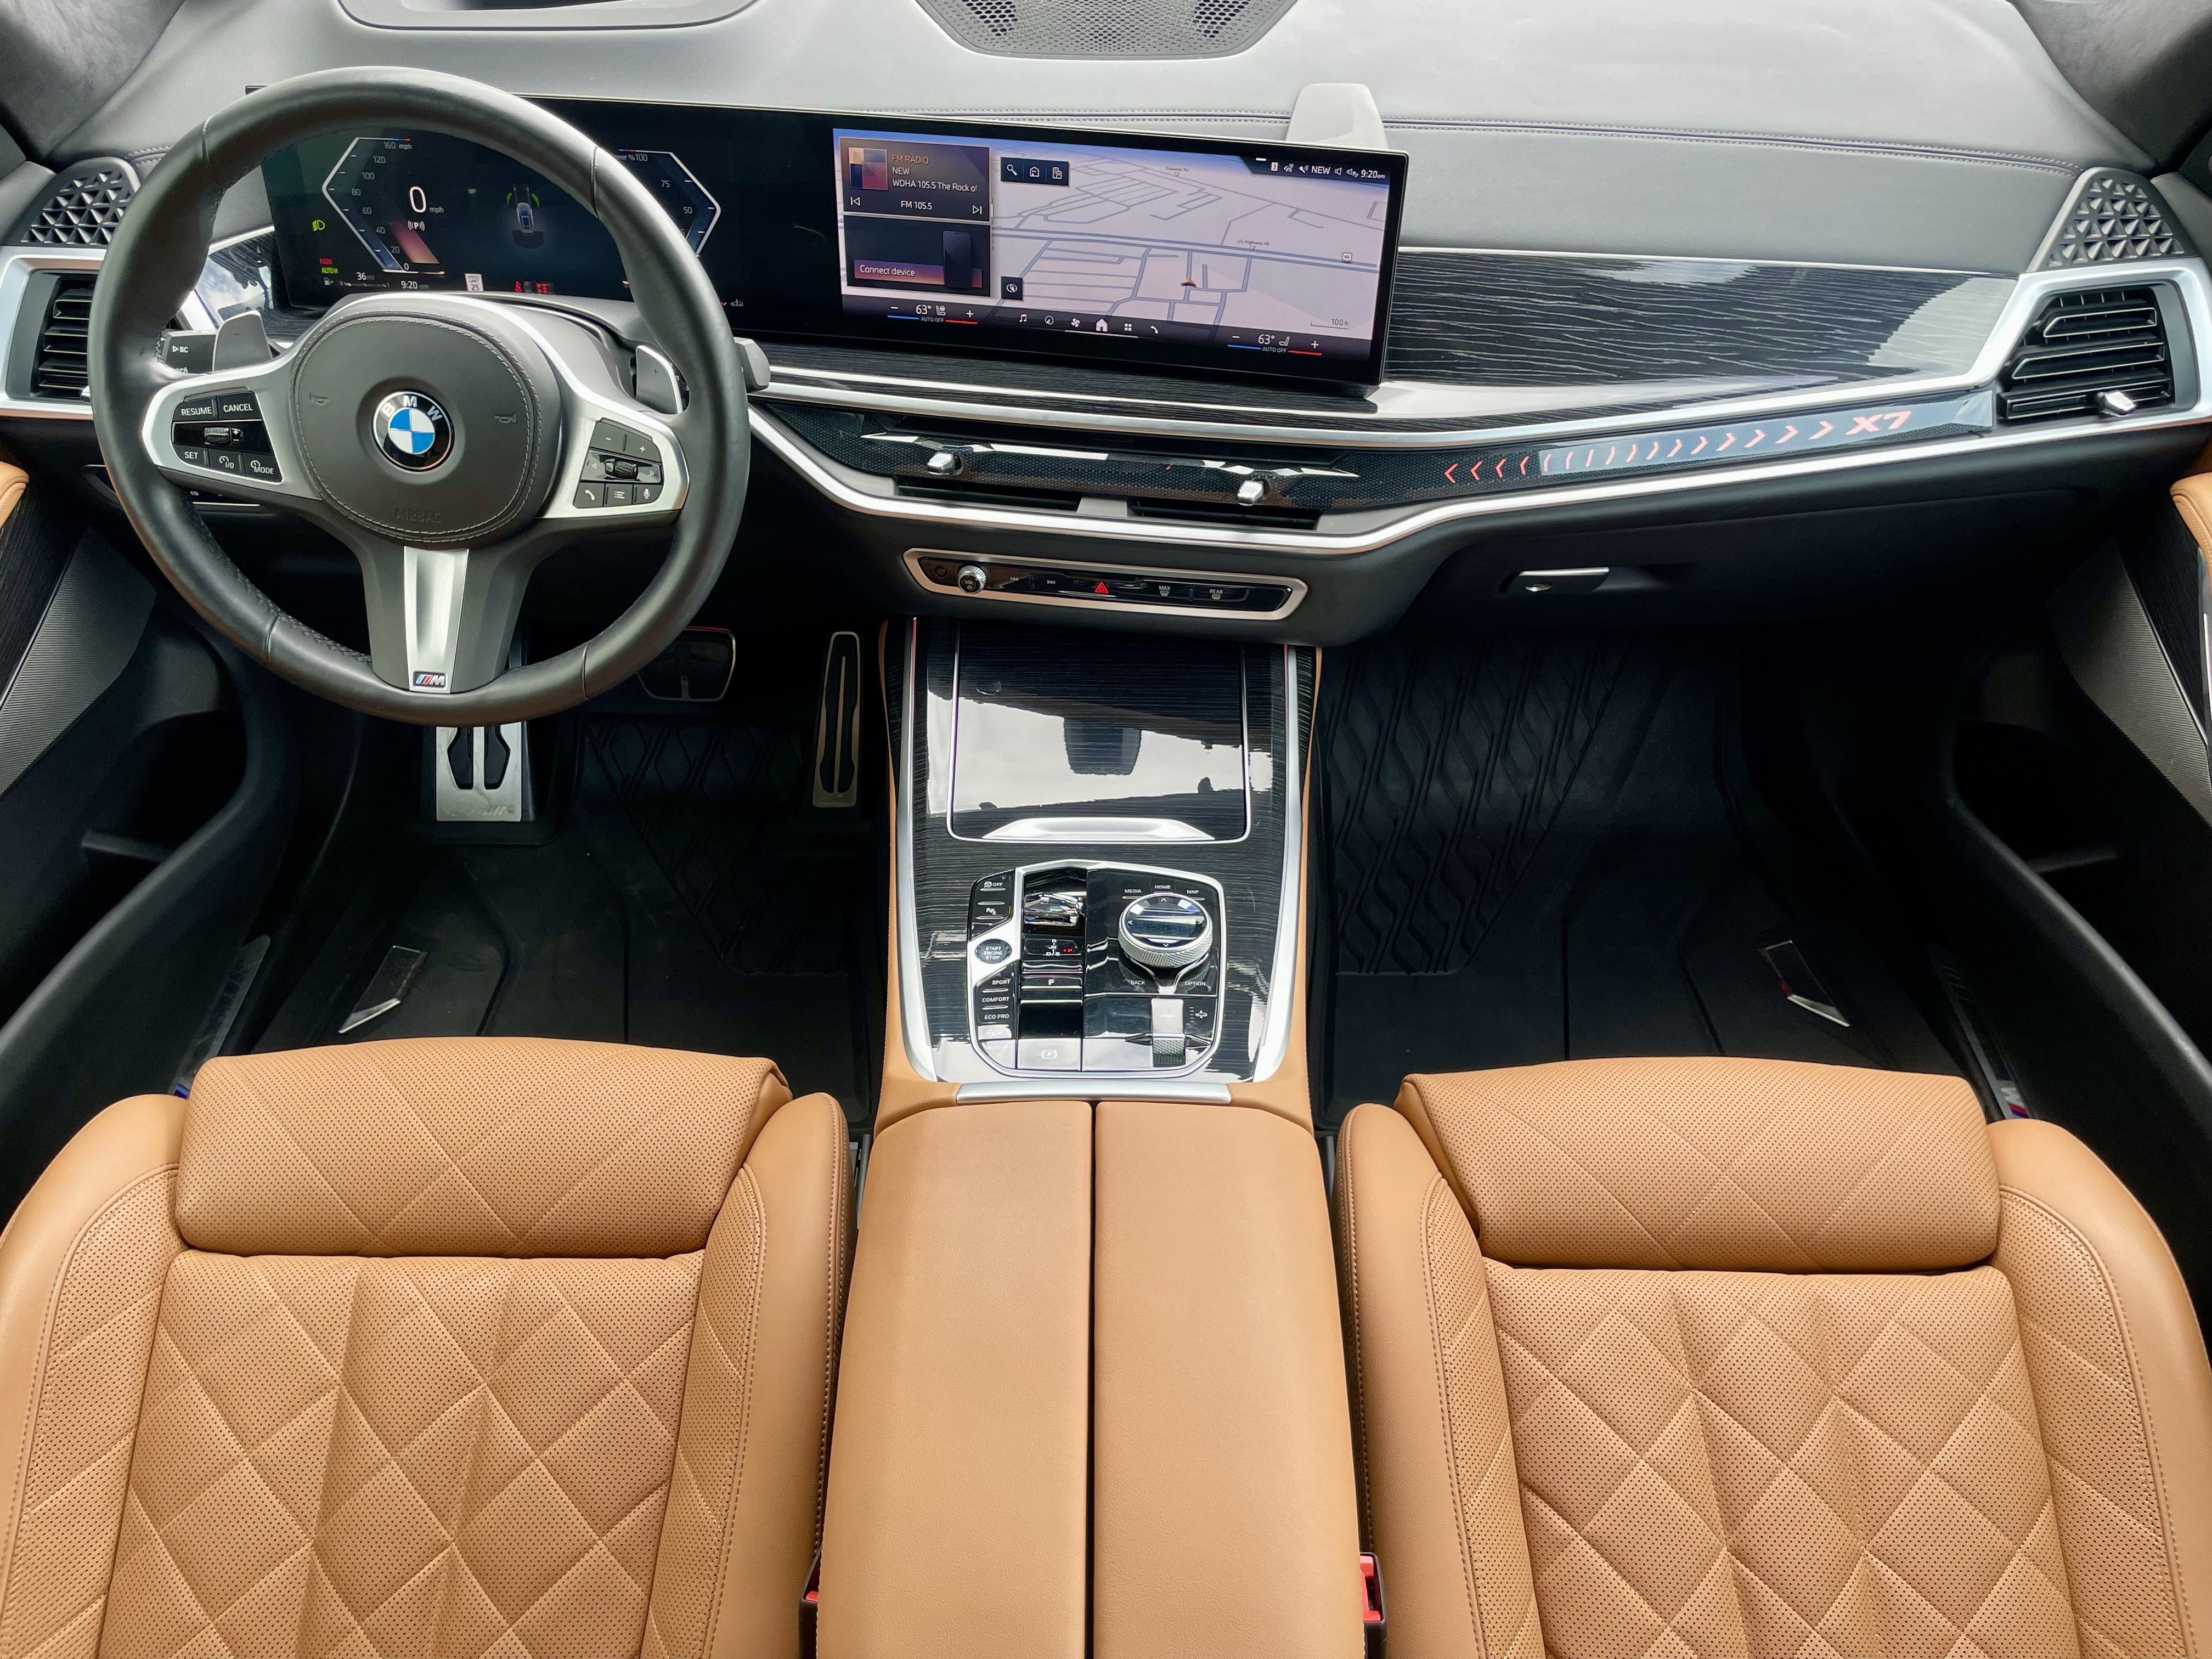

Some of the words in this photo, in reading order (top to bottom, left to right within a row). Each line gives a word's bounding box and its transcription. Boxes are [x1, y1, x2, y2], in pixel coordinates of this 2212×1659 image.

[383, 142, 396, 150] 160
[891, 154, 904, 163] FM
[906, 155, 929, 165] RADIO
[892, 167, 911, 176] NEW
[1311, 166, 1331, 174] NEW
[361, 172, 375, 180] 100
[661, 180, 670, 188] 75
[893, 179, 916, 188] WDHA
[918, 180, 936, 189] 105.5
[938, 182, 951, 190] The
[952, 183, 969, 191] Rock
[409, 186, 427, 213] 0
[900, 200, 912, 208] FM
[914, 201, 933, 210] 105.5
[860, 265, 890, 275] Connect
[891, 267, 916, 276] device
[400, 281, 418, 290] 9:20
[181, 407, 213, 416] RESUME
[223, 403, 253, 413] CANCEL
[381, 394, 443, 422] BMW
[1845, 410, 1912, 436] X7
[253, 466, 274, 475] MODE
